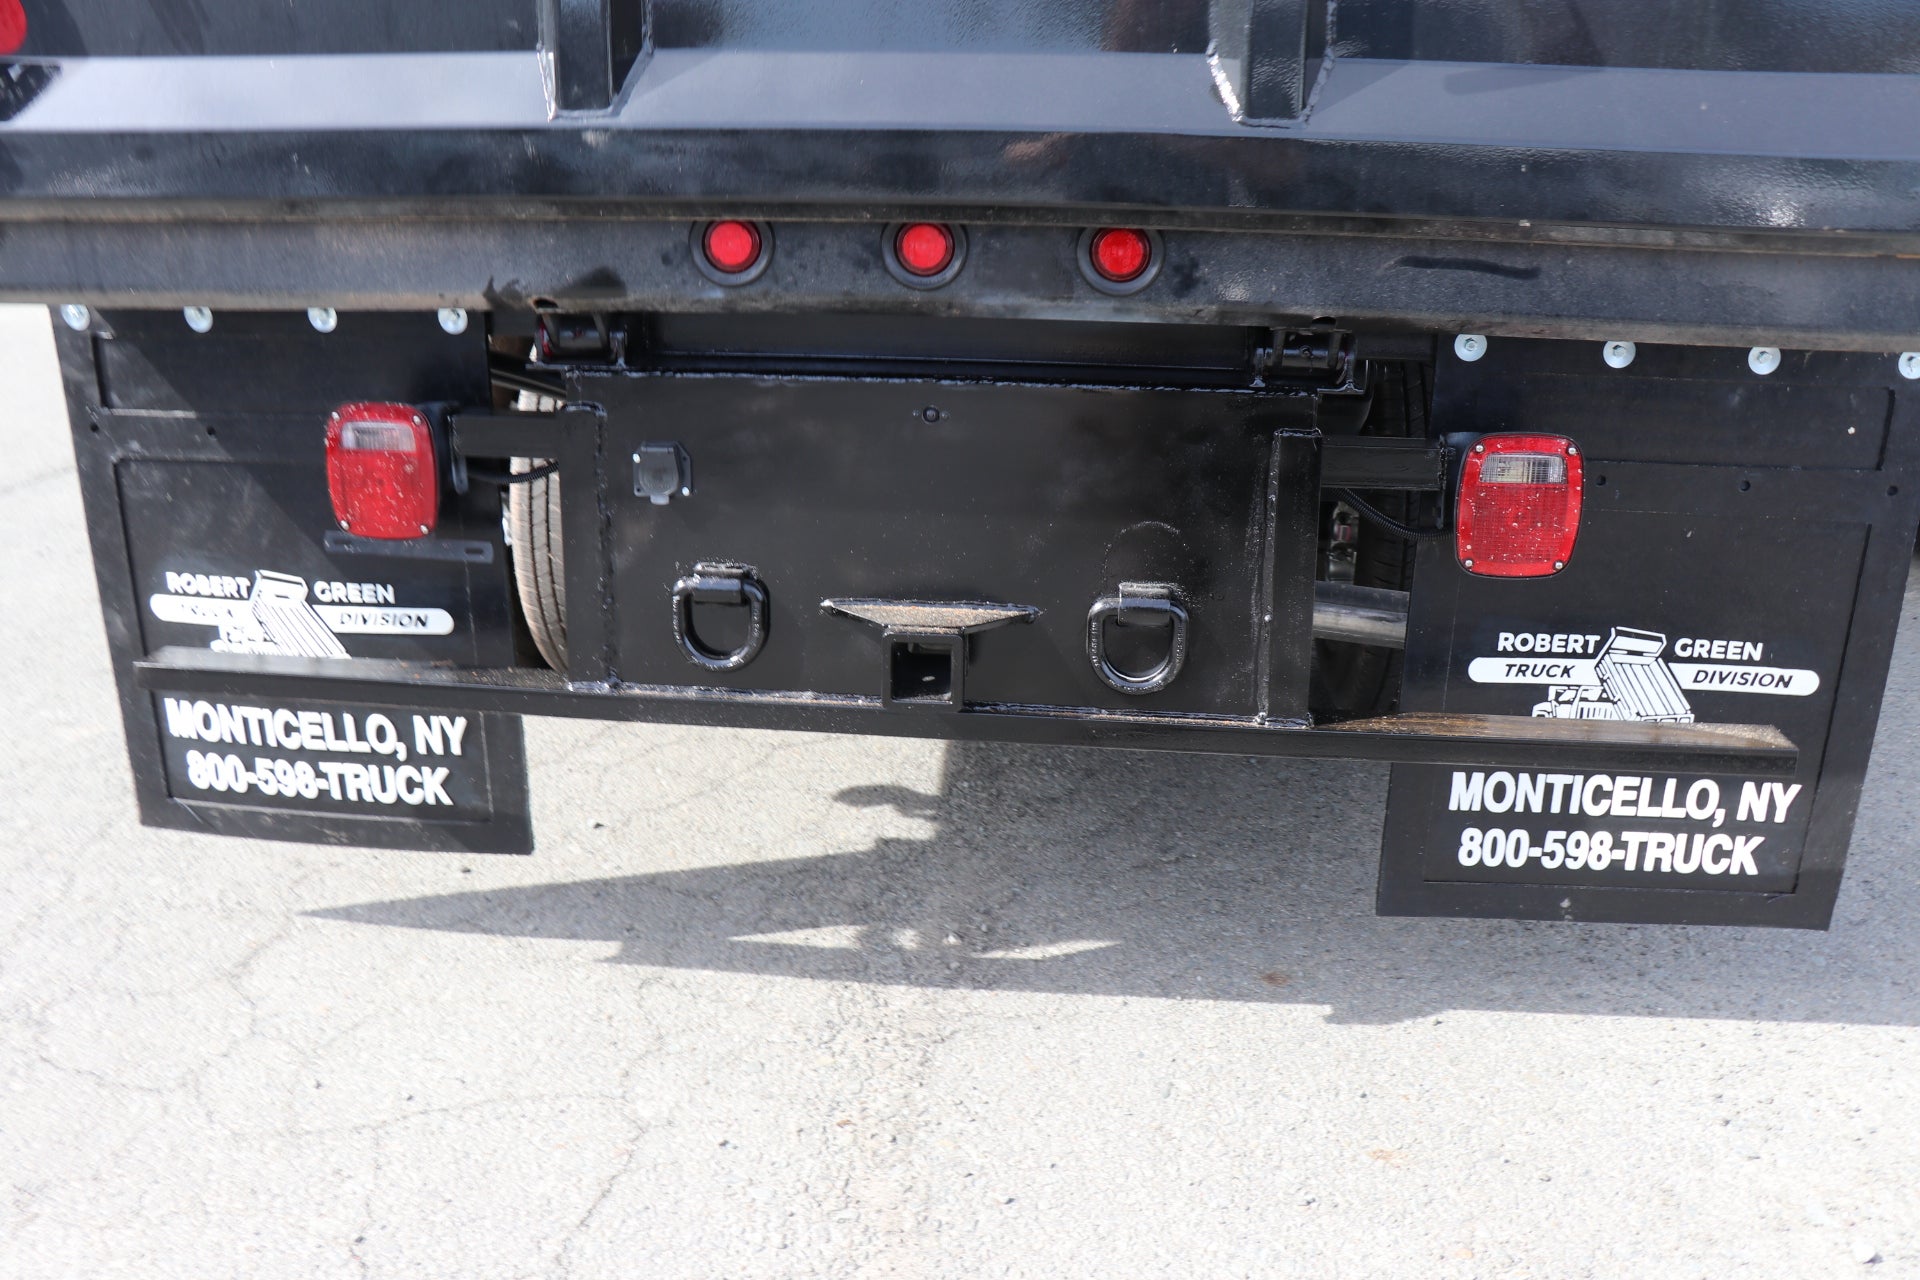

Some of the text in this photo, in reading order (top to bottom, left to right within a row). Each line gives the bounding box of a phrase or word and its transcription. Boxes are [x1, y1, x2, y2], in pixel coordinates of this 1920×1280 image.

[313, 580, 396, 605] GREEN
[339, 612, 428, 629] DIVISION
[1497, 631, 1764, 662] ROBERT GREEN
[1504, 663, 1794, 689] TRUCK DIVISION
[164, 697, 468, 762] MONTICELLO, NY
[185, 751, 455, 807] 800-598-TRUCK
[1448, 771, 1802, 828] MONTICELLO, NY
[1458, 827, 1765, 877] 800-598-TRUCK
